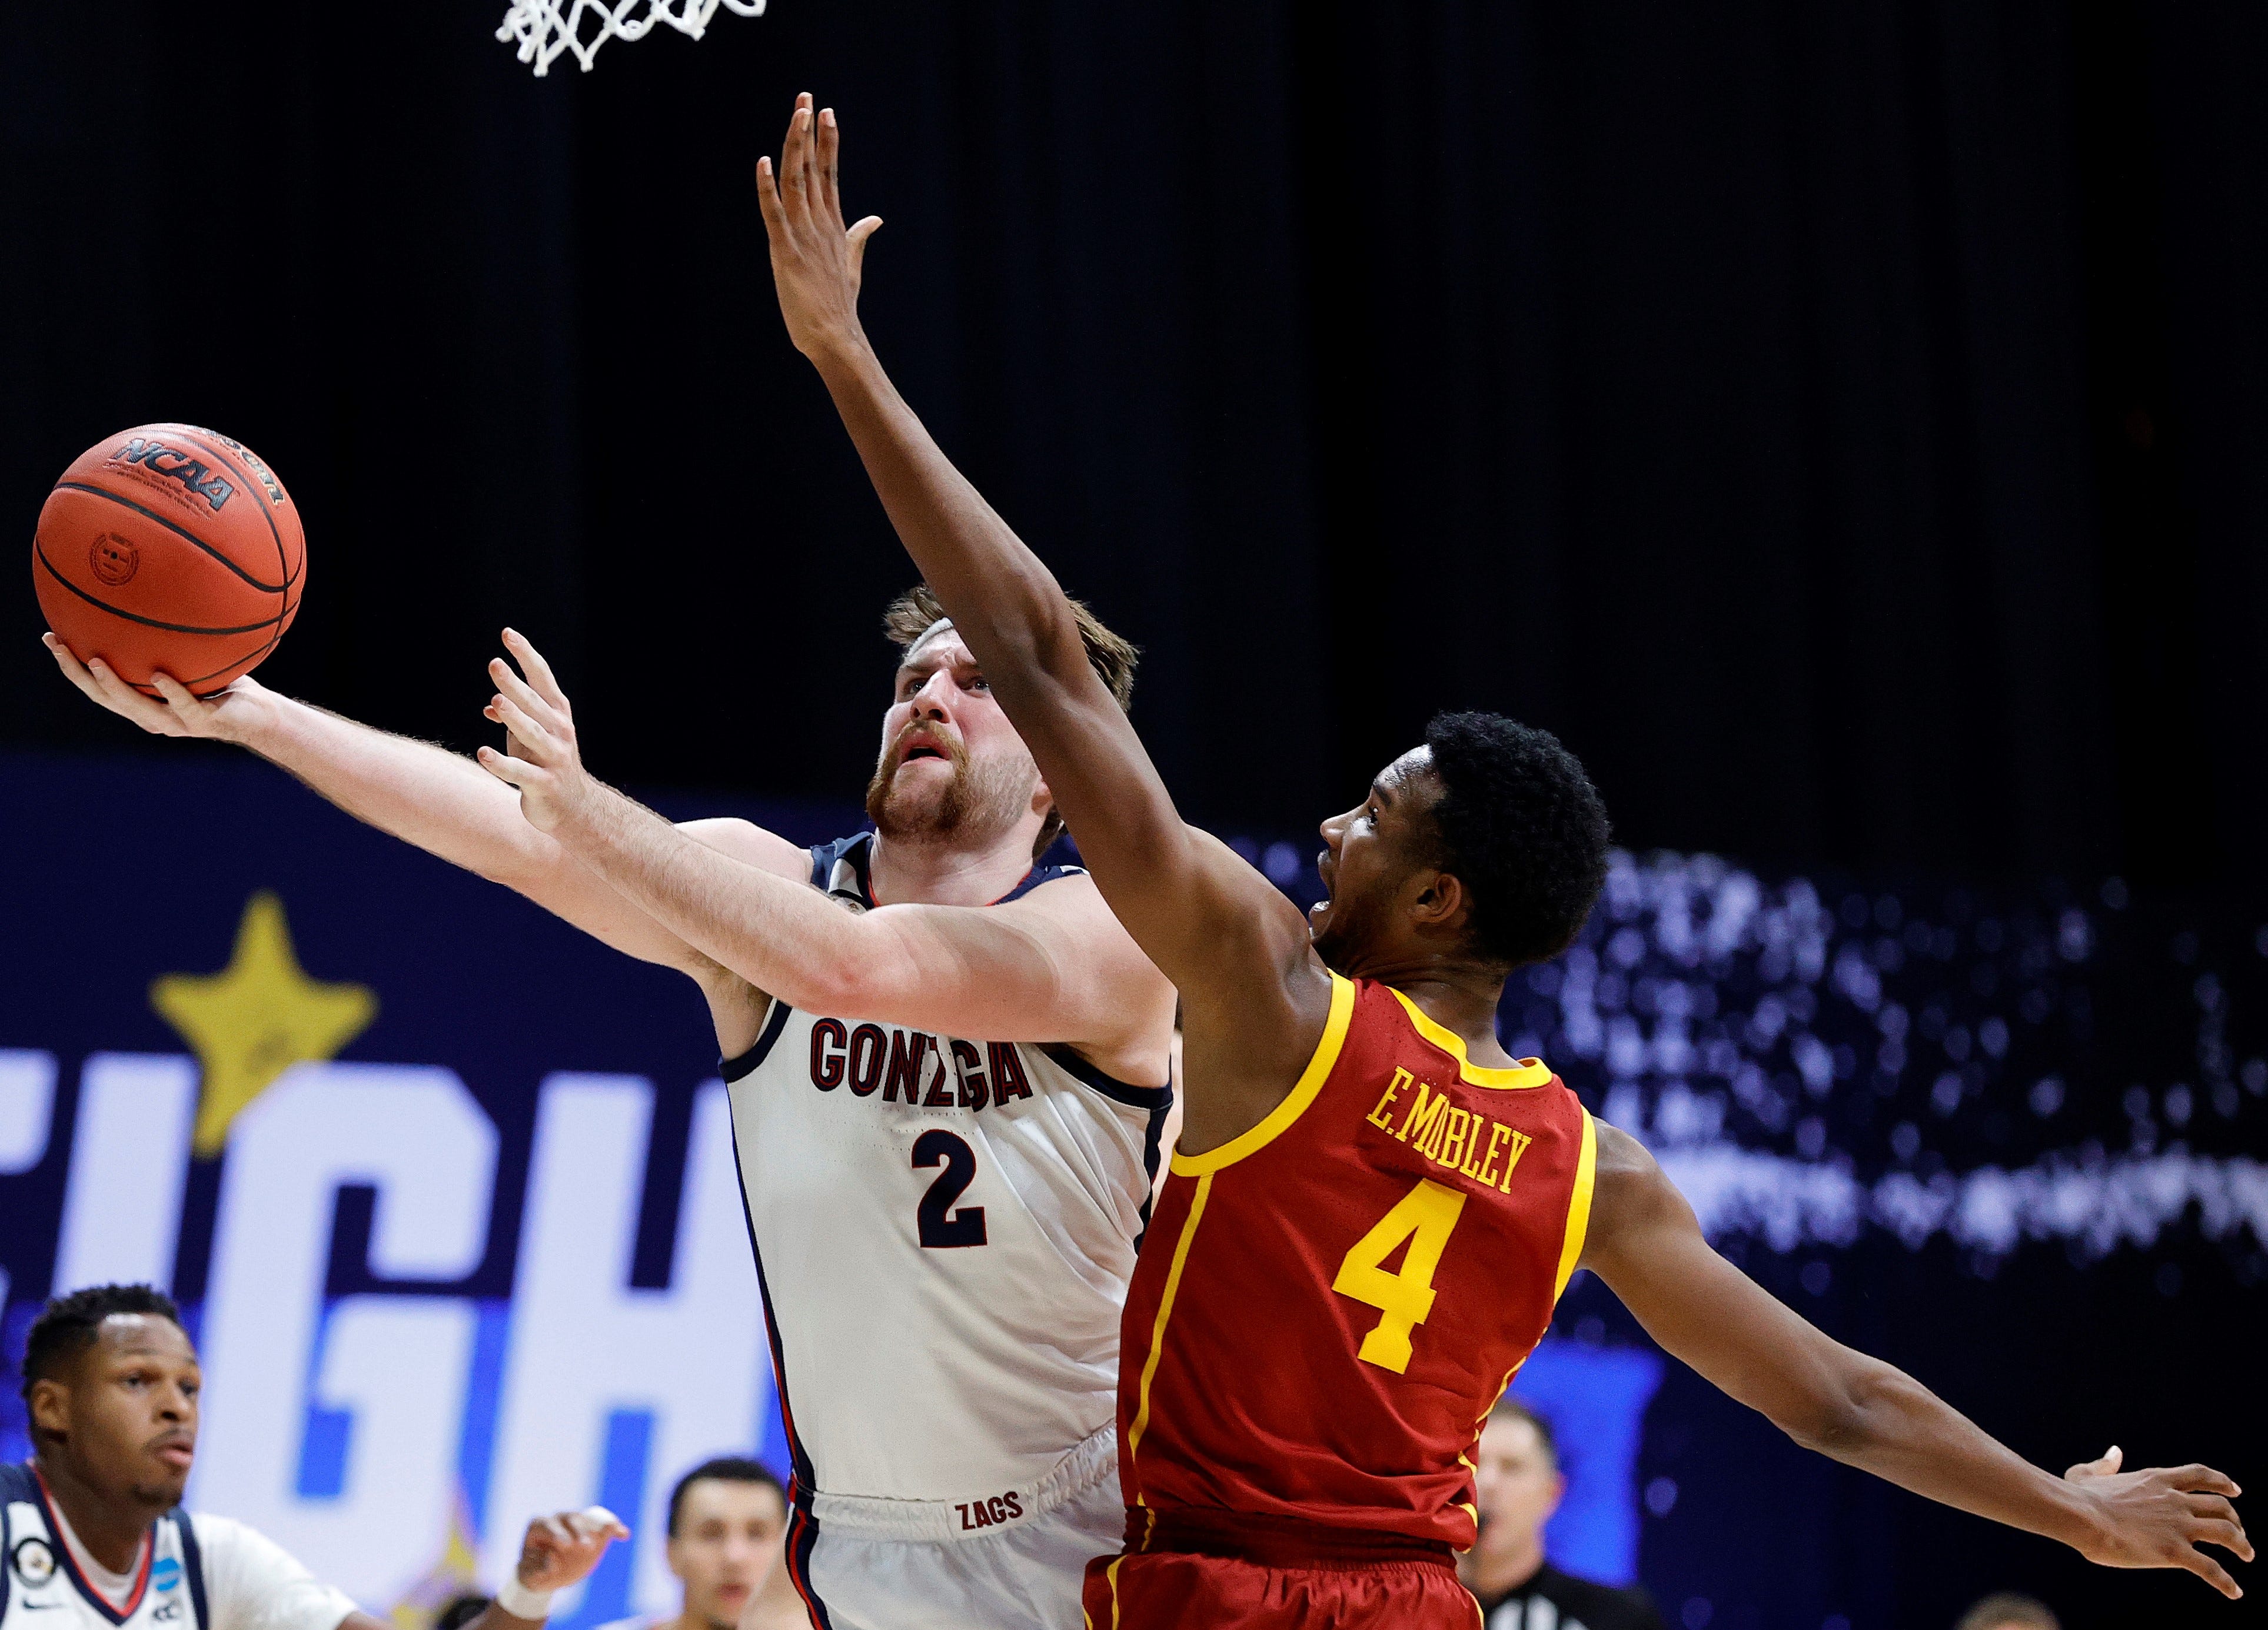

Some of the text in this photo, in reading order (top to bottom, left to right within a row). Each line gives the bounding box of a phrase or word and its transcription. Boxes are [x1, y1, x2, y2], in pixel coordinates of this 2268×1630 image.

[108, 438, 235, 512] NCAA
[810, 1017, 1033, 1113] GONZGA
[911, 1129, 988, 1249] 2
[1331, 1177, 1468, 1375] 4
[955, 1491, 1024, 1531] ZAGS
